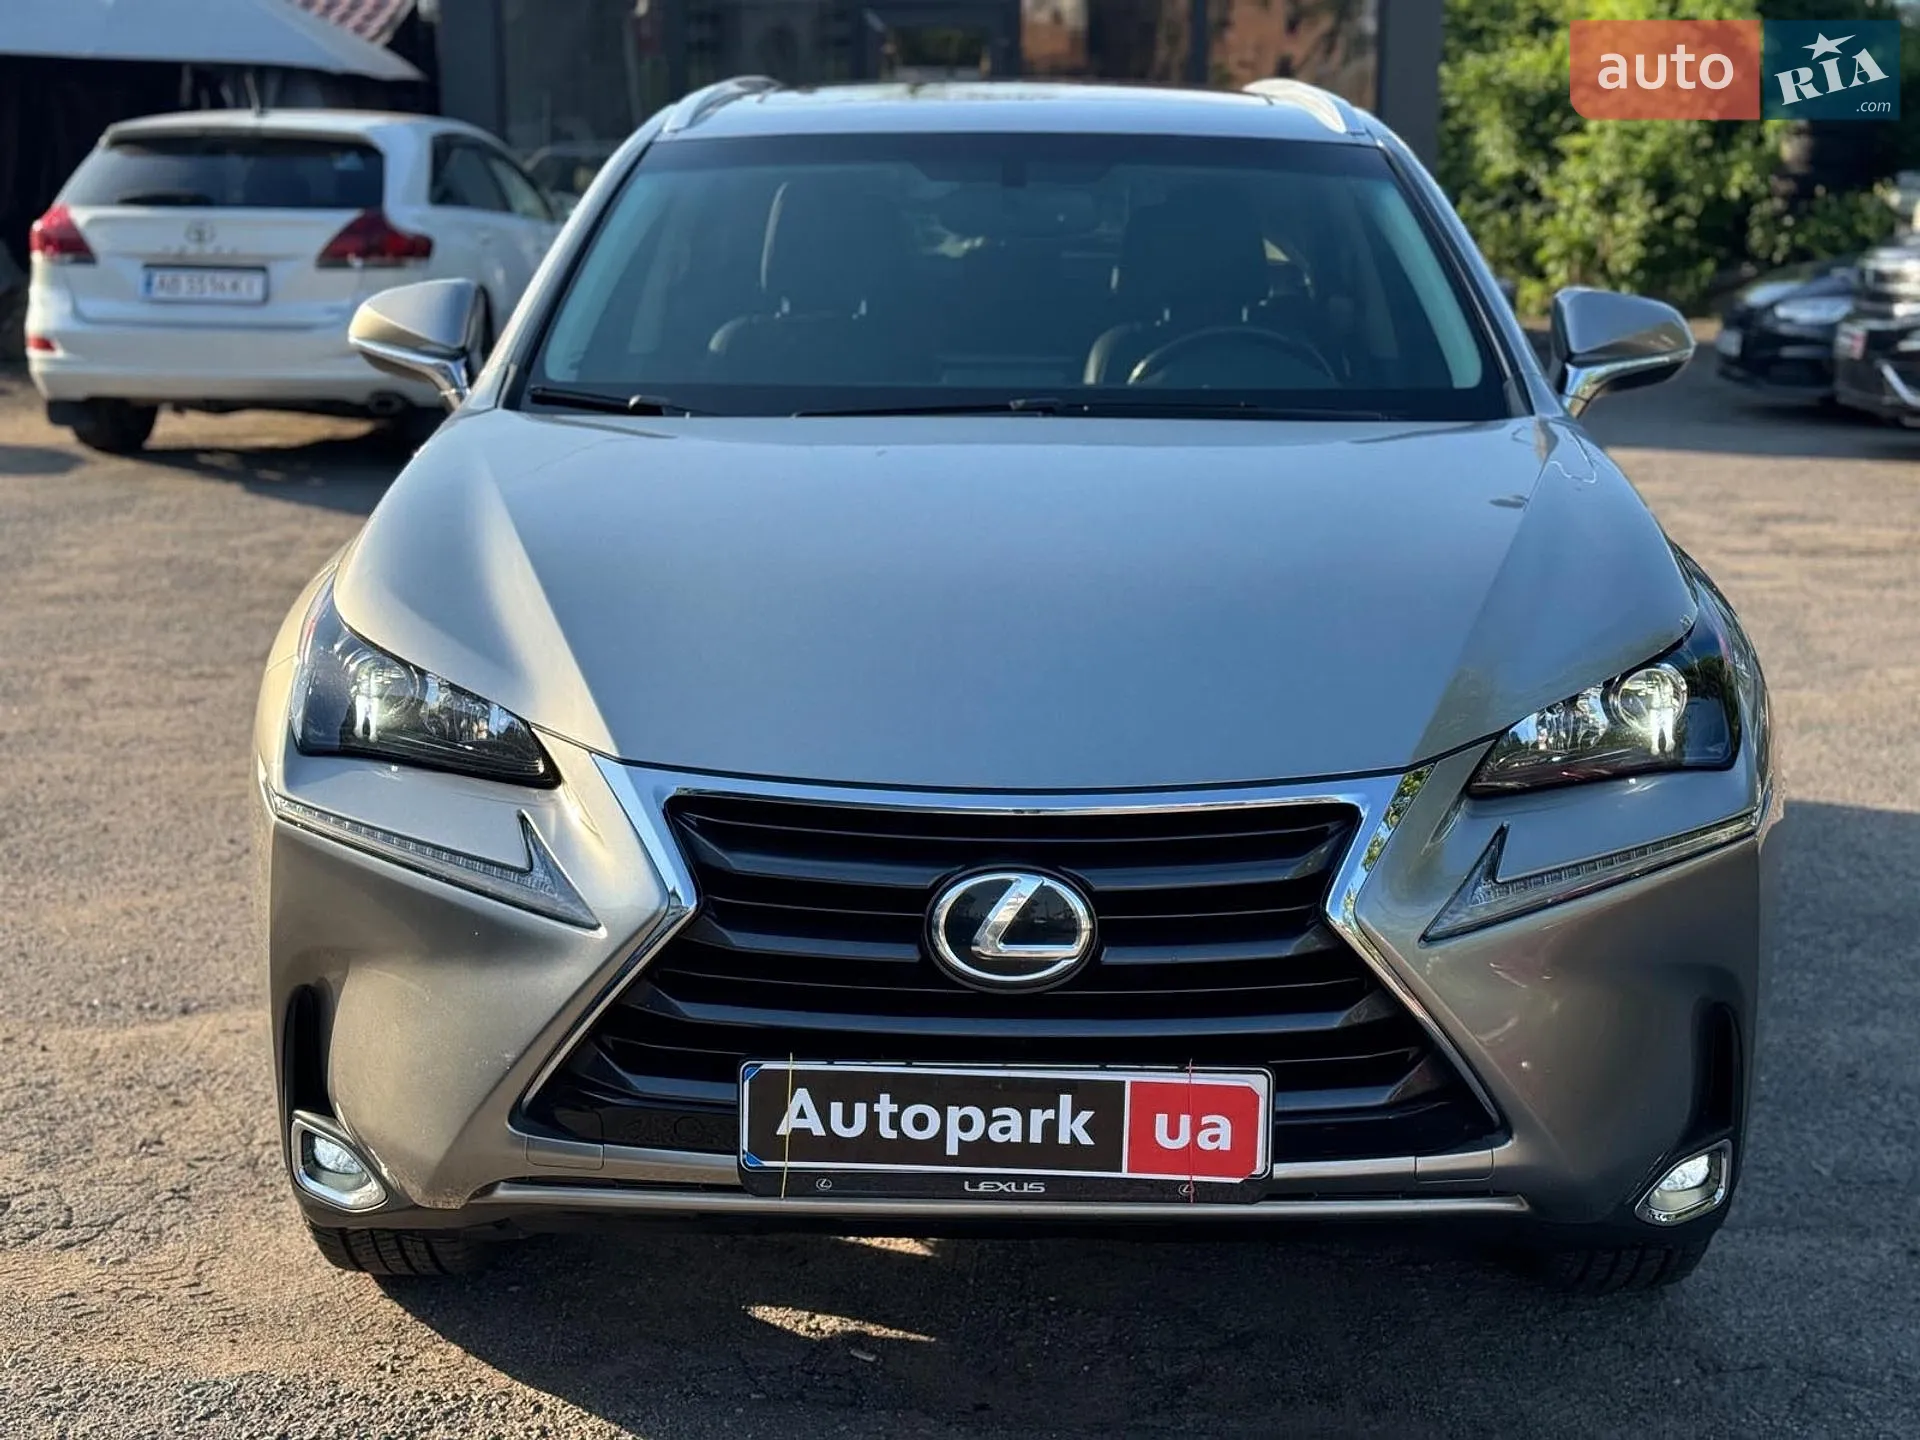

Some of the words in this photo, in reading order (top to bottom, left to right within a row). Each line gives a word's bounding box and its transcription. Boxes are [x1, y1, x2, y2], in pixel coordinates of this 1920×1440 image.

[775, 1087, 1096, 1156] Autopark
[1154, 1113, 1233, 1151] ua
[963, 1180, 1046, 1194] LEXUS
